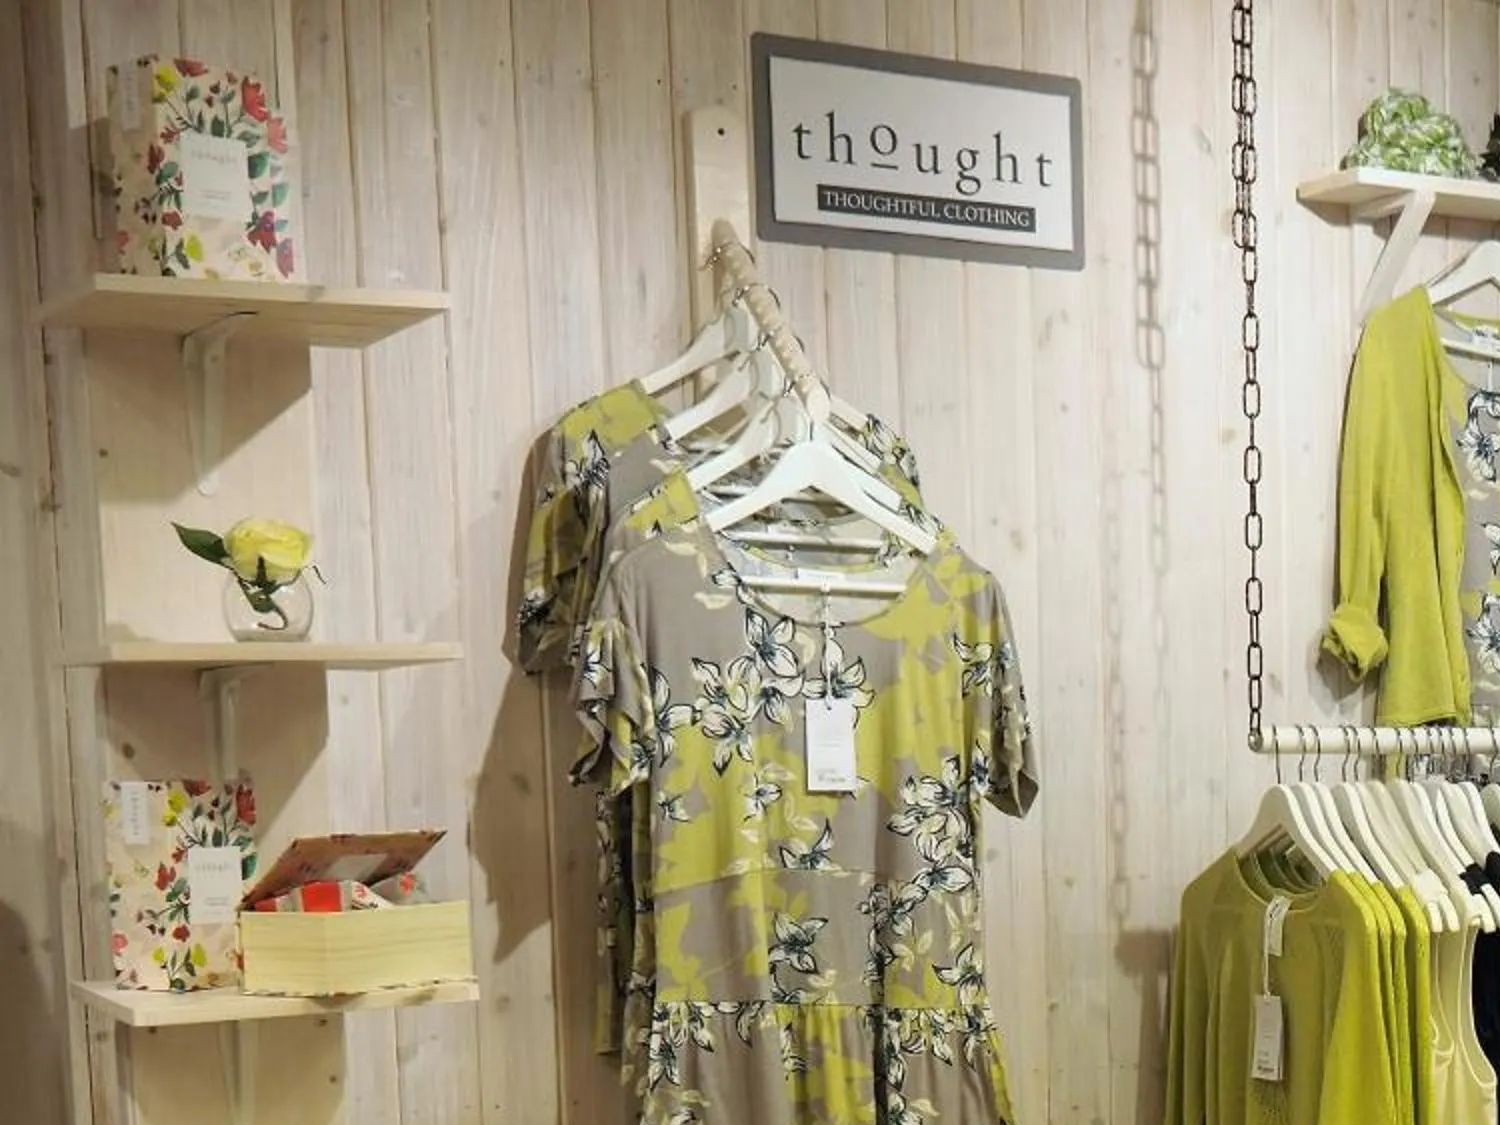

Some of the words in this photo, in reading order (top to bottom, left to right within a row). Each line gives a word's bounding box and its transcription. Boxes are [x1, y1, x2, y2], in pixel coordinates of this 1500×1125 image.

[792, 111, 1053, 196] thought
[823, 191, 941, 219] THOUGHTFUL
[943, 204, 1030, 227] CLOTHING
